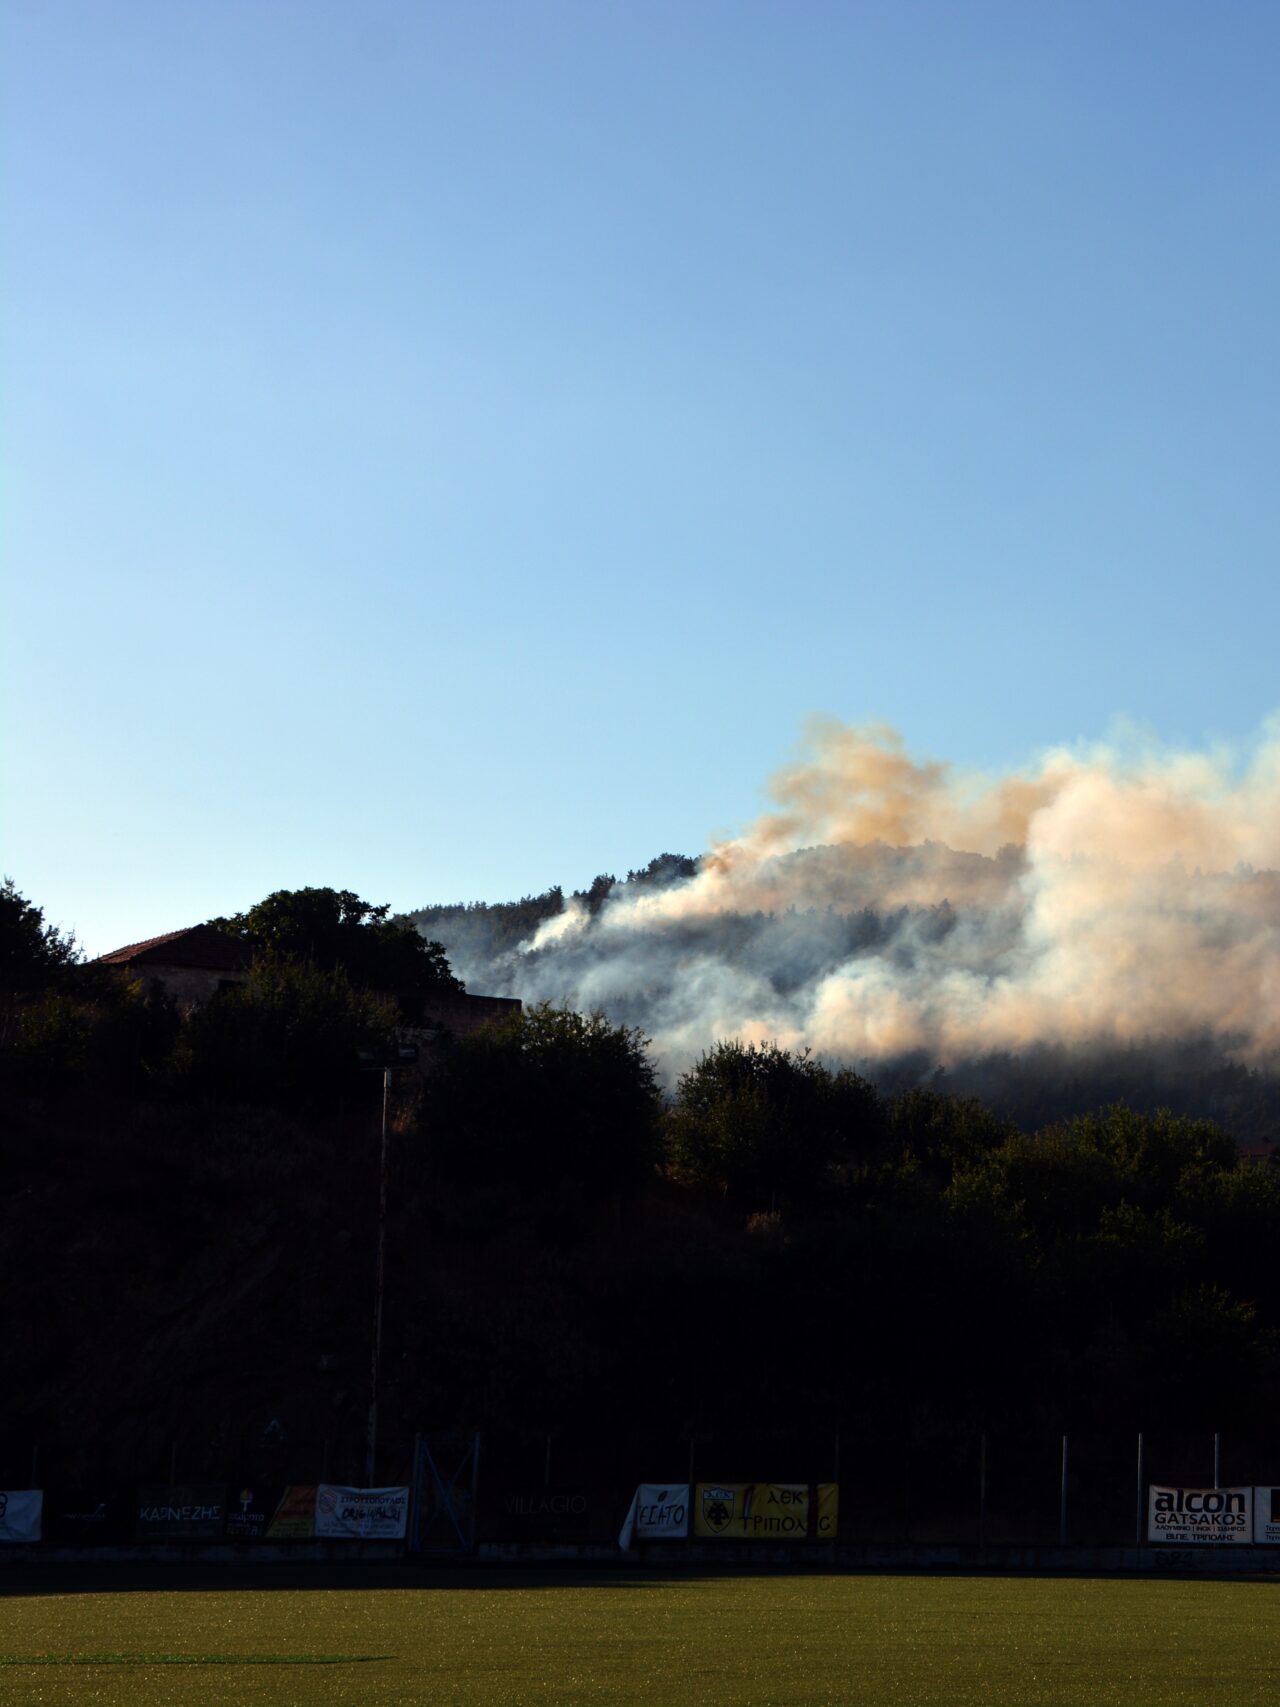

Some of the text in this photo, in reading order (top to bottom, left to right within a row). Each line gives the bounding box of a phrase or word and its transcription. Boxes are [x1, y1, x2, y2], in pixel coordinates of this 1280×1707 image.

[1155, 1488, 1245, 1513] alcon
[1154, 1512, 1245, 1525] GATSAKOS
[1192, 1533, 1235, 1541] ΤΡΙΠΟΛΗΣ
